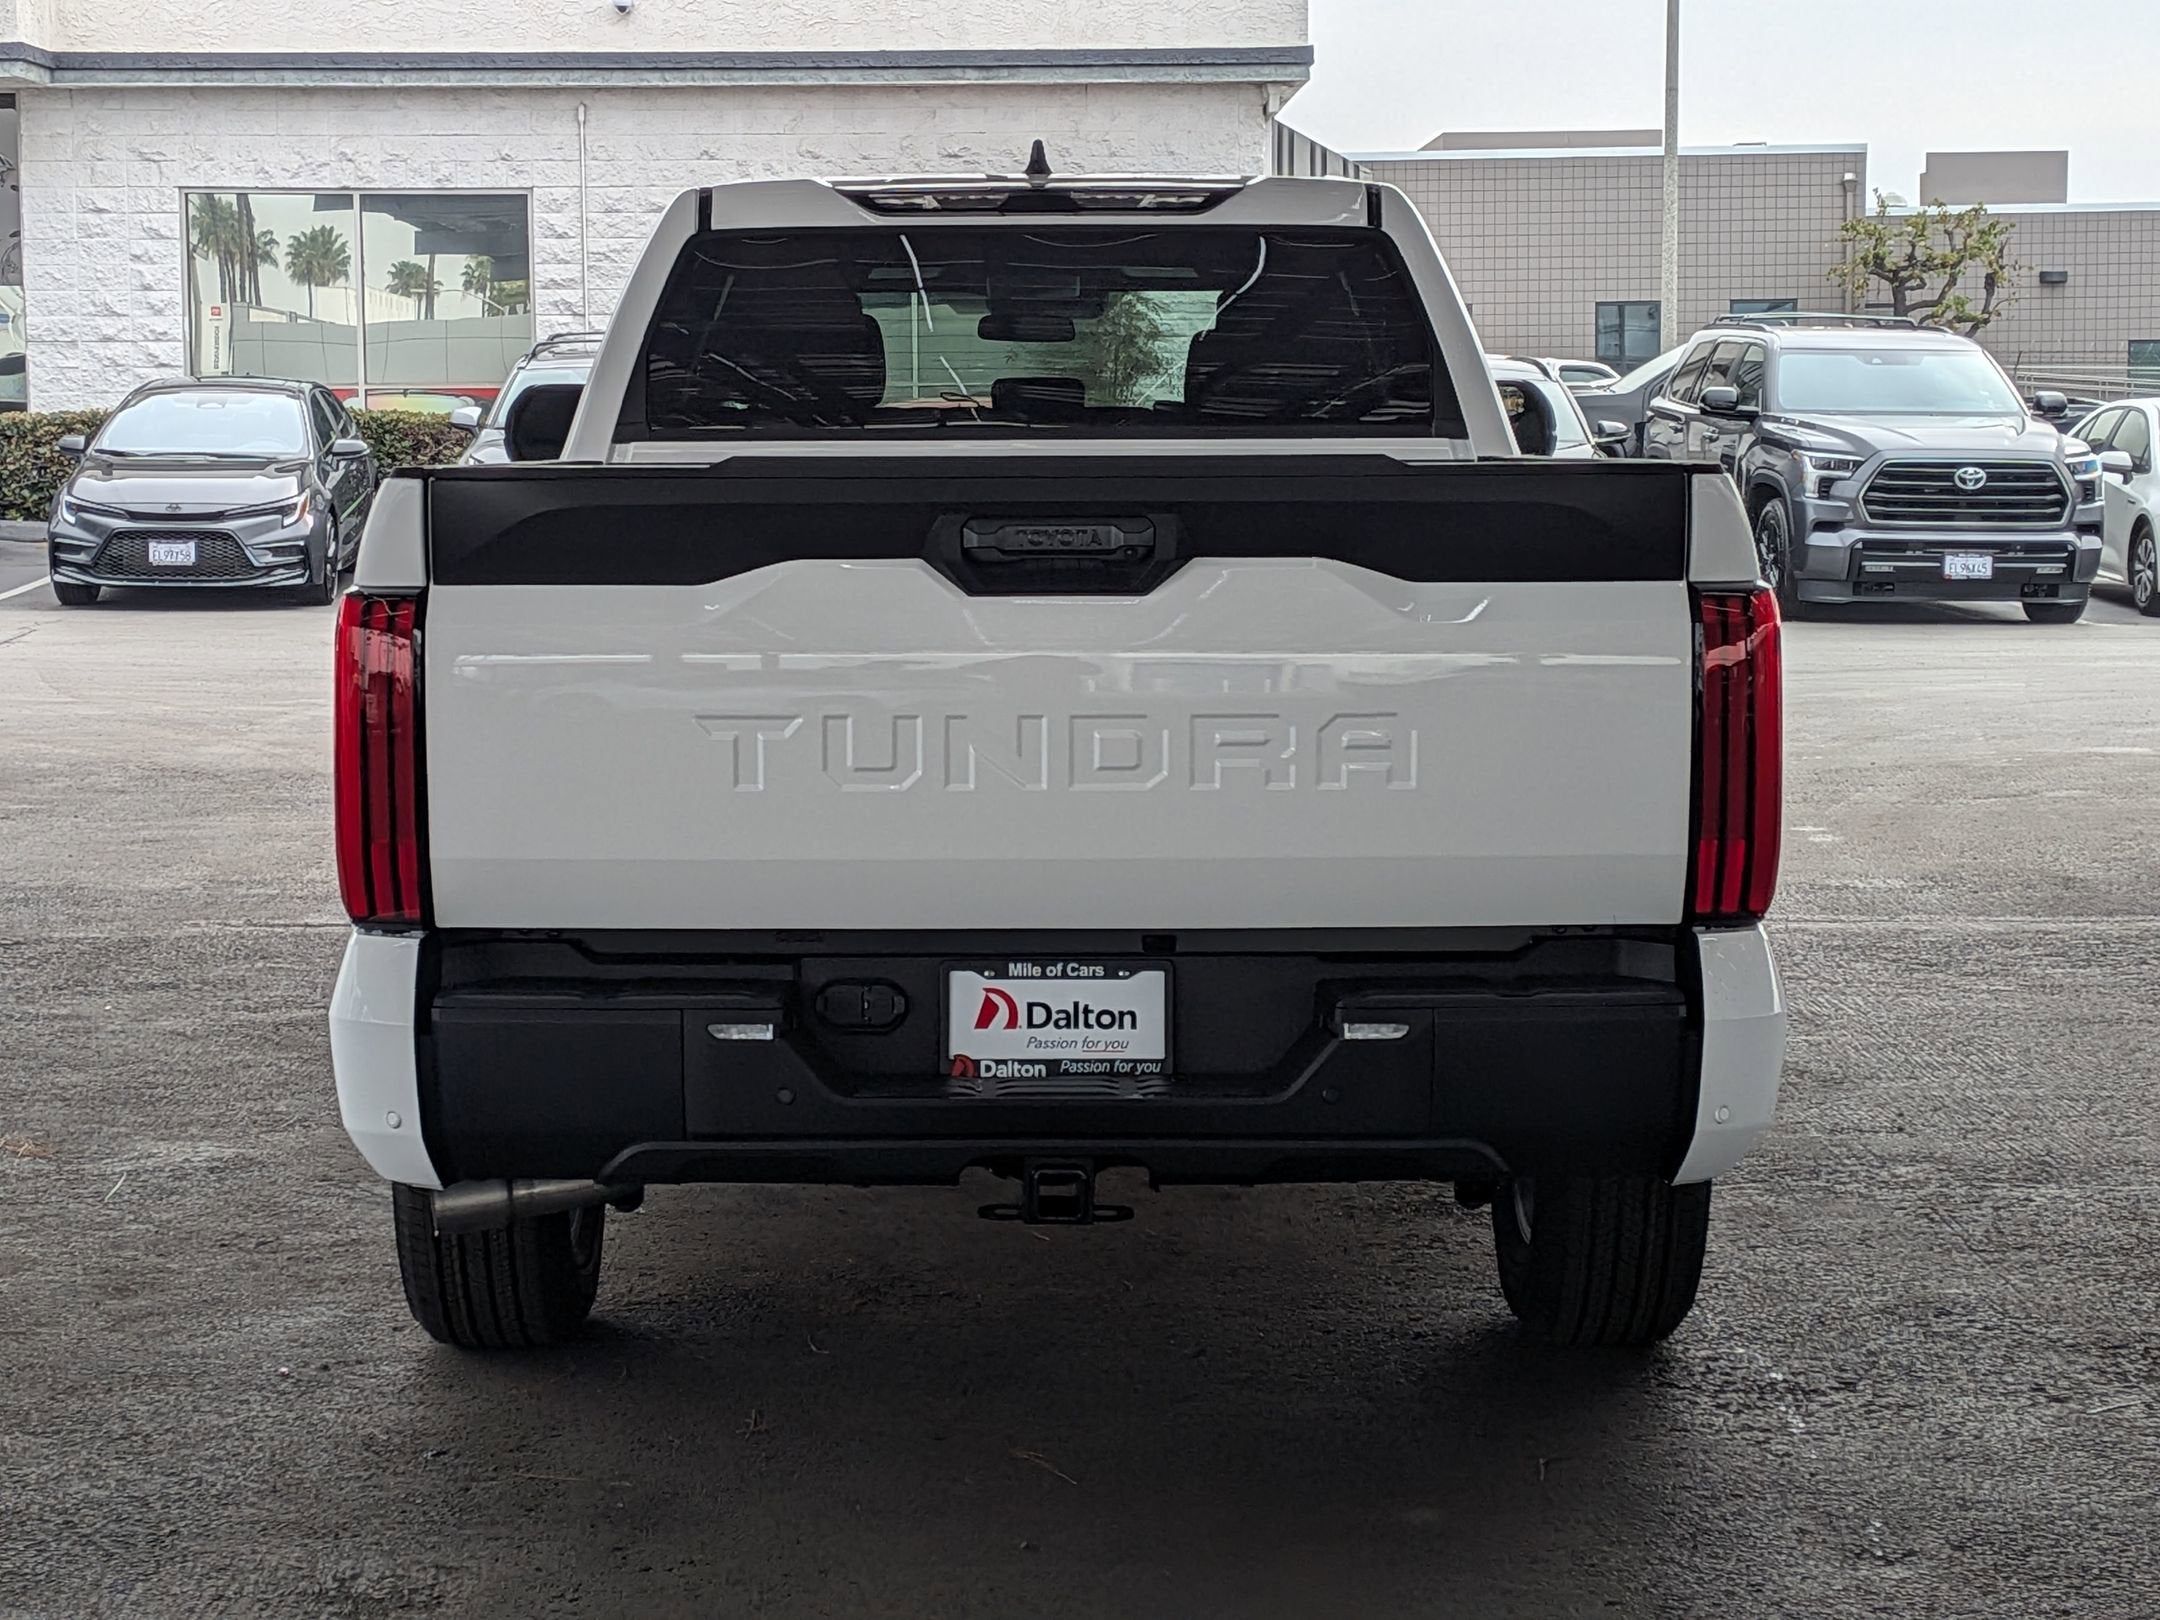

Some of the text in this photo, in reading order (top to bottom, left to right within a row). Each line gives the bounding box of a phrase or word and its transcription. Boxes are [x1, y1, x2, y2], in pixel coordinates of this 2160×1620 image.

[1016, 528, 1103, 547] TOYOTA
[692, 713, 1417, 791] TUNDRA
[1008, 962, 1105, 977] Mile of Cars
[1027, 1001, 1137, 1030] Dalton
[1026, 1036, 1130, 1052] Passion for you
[980, 1060, 1162, 1078] Dalton Passion for you
